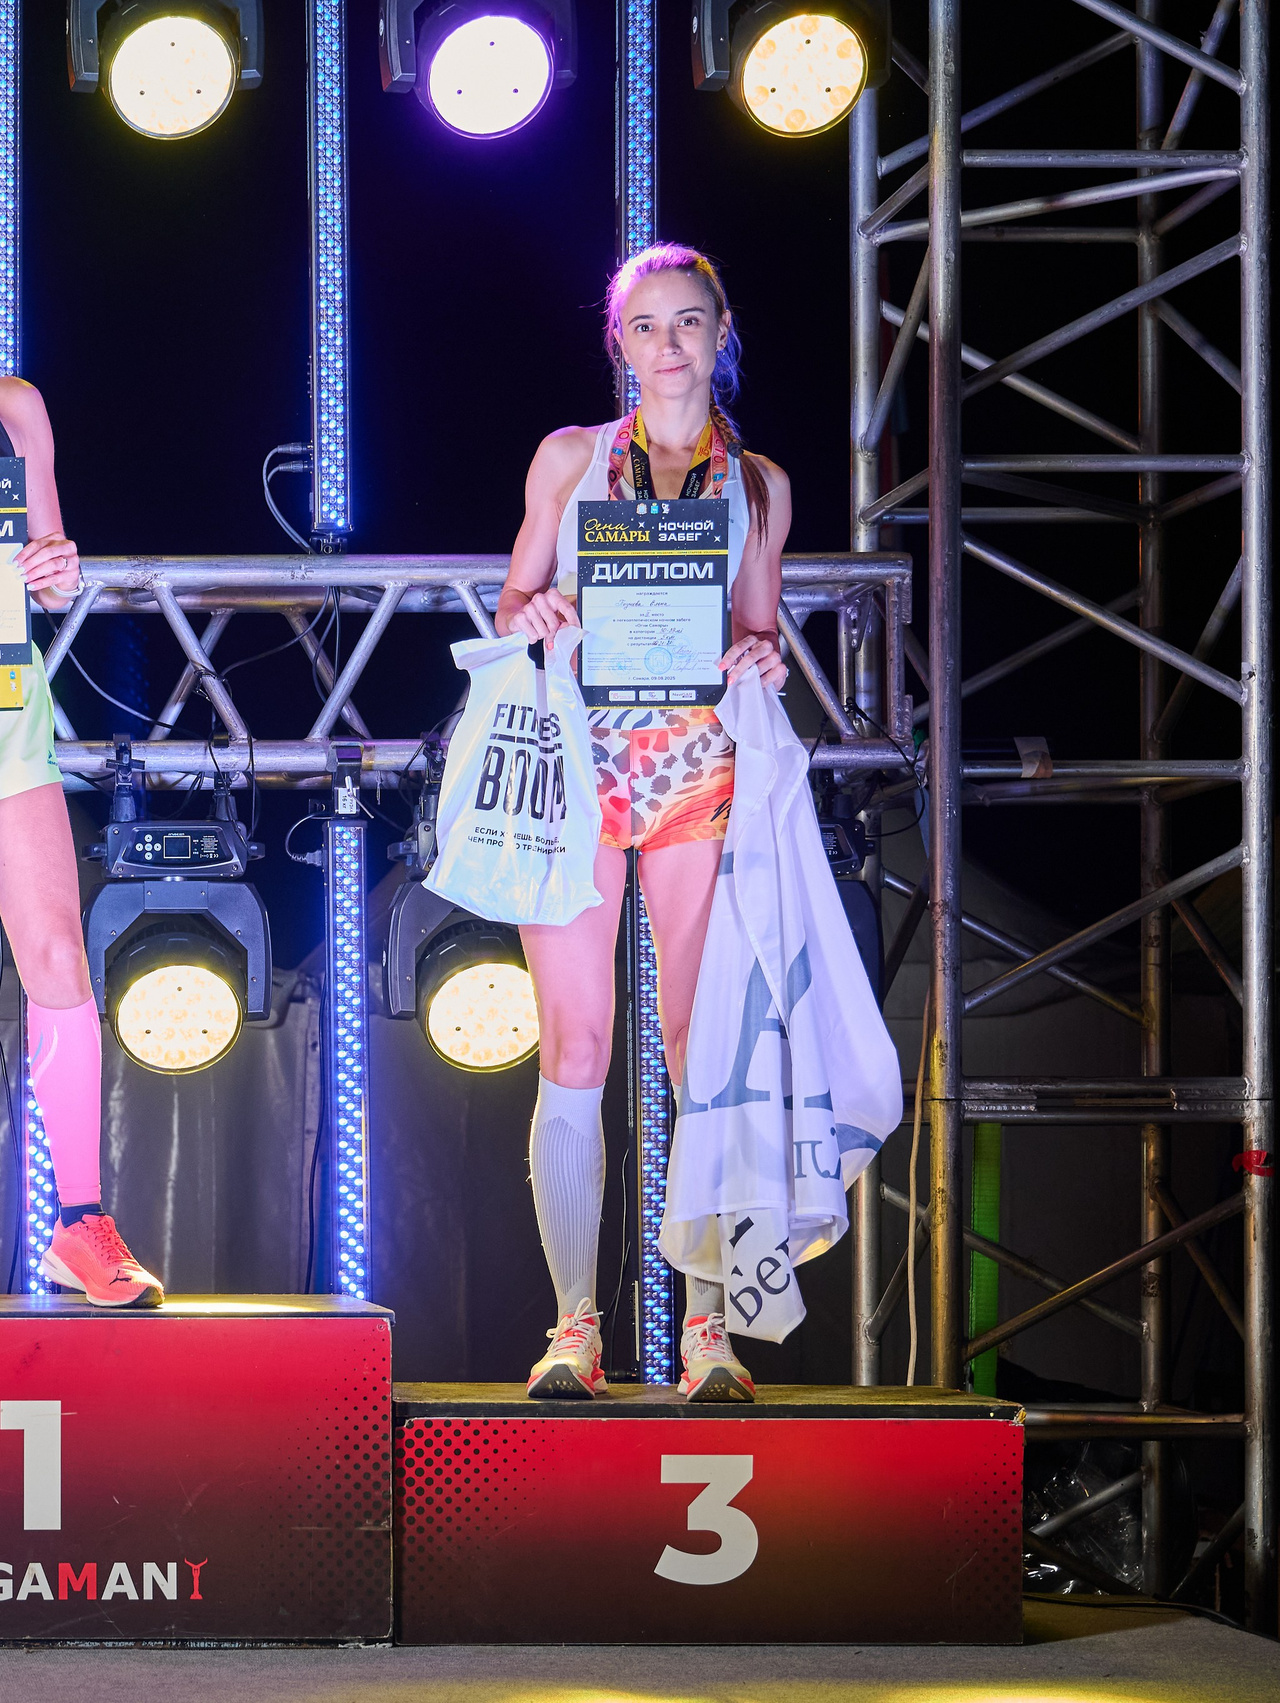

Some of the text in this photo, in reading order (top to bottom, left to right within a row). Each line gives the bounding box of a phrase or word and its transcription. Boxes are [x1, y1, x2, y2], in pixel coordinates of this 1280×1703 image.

[584, 518, 630, 531] Огни
[658, 520, 714, 531] НОЧНОЙ
[585, 530, 650, 542] САМАРЫ
[658, 533, 702, 542] ЗАБЕГ
[592, 562, 713, 583] ДИПЛОМ
[474, 826, 498, 836] ЕСЛИ
[0, 1400, 62, 1531] 1
[654, 1454, 758, 1586] 3
